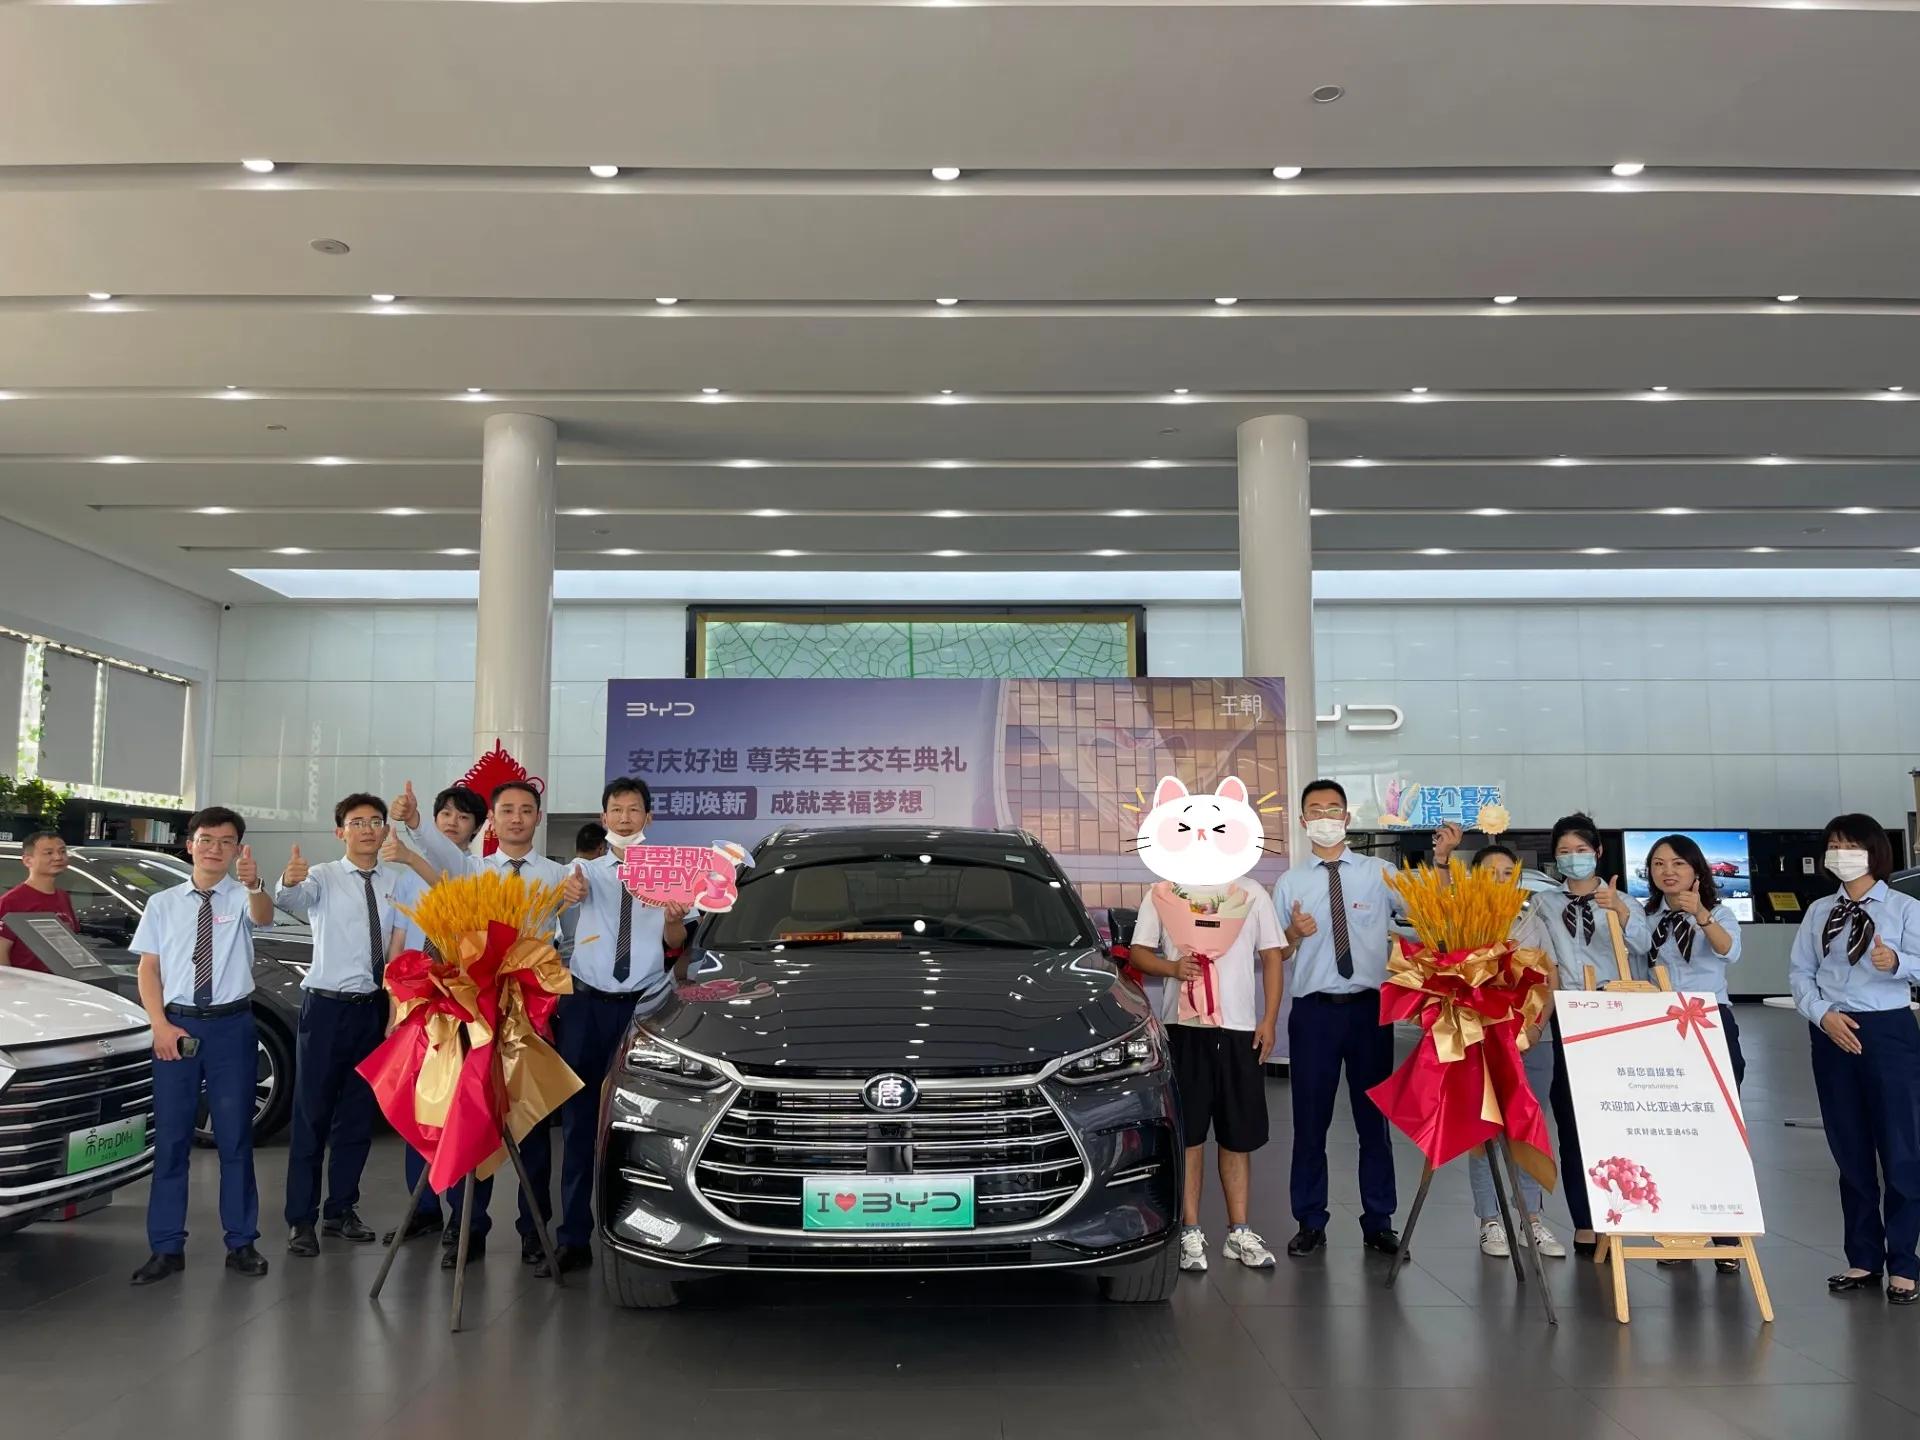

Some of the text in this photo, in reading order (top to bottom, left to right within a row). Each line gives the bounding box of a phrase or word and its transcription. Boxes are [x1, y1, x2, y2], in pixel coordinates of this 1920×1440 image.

[626, 702, 695, 717] BYD
[1219, 694, 1262, 724] 王朝
[628, 746, 968, 774] 安庆好迪 尊荣车主交车典礼
[650, 790, 923, 815] 王朝焕新 成就幸福梦想
[1420, 786, 1500, 807] 这个夏天
[617, 865, 699, 891] HAPPY
[877, 1078, 904, 1106] 唐
[1600, 1100, 1715, 1112] 欢迎加入比亚迪大家庭
[816, 1191, 962, 1213] I BYD
